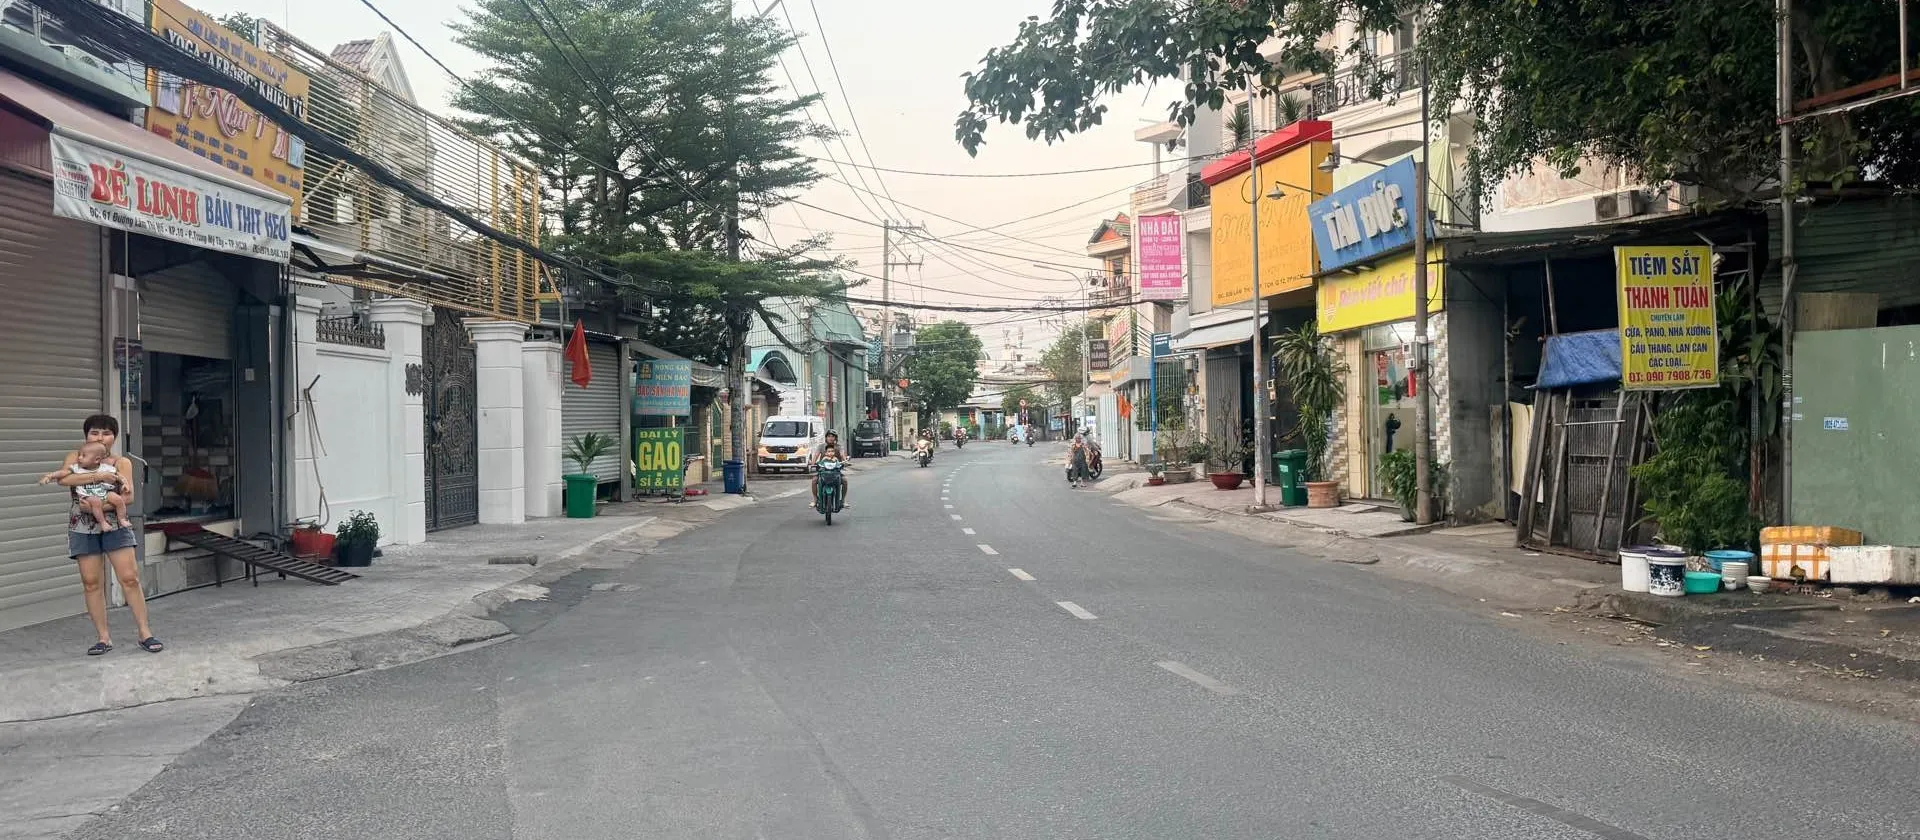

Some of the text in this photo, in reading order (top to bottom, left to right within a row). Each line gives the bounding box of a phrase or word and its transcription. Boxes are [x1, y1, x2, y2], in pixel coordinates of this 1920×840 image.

[135, 175, 199, 226] LINH
[1358, 179, 1408, 239] ĐỨC
[205, 192, 287, 241] BÁN THỊT HEO
[1161, 217, 1179, 236] ĐẤT
[1629, 249, 1700, 280] TIỆM SẮT
[1624, 278, 1709, 309] THANH TUẤN
[1625, 324, 1711, 338] CỬA, PANO, NHÀ XƯỞNG
[1630, 341, 1707, 354] CẦU THANG, LAN CAN
[1648, 356, 1663, 367] CÁC
[1629, 369, 1711, 382] ĐT: 090 7908 736
[640, 430, 679, 440] ĐẠI LÝ
[639, 441, 680, 477] GẠO
[655, 477, 663, 487] &
